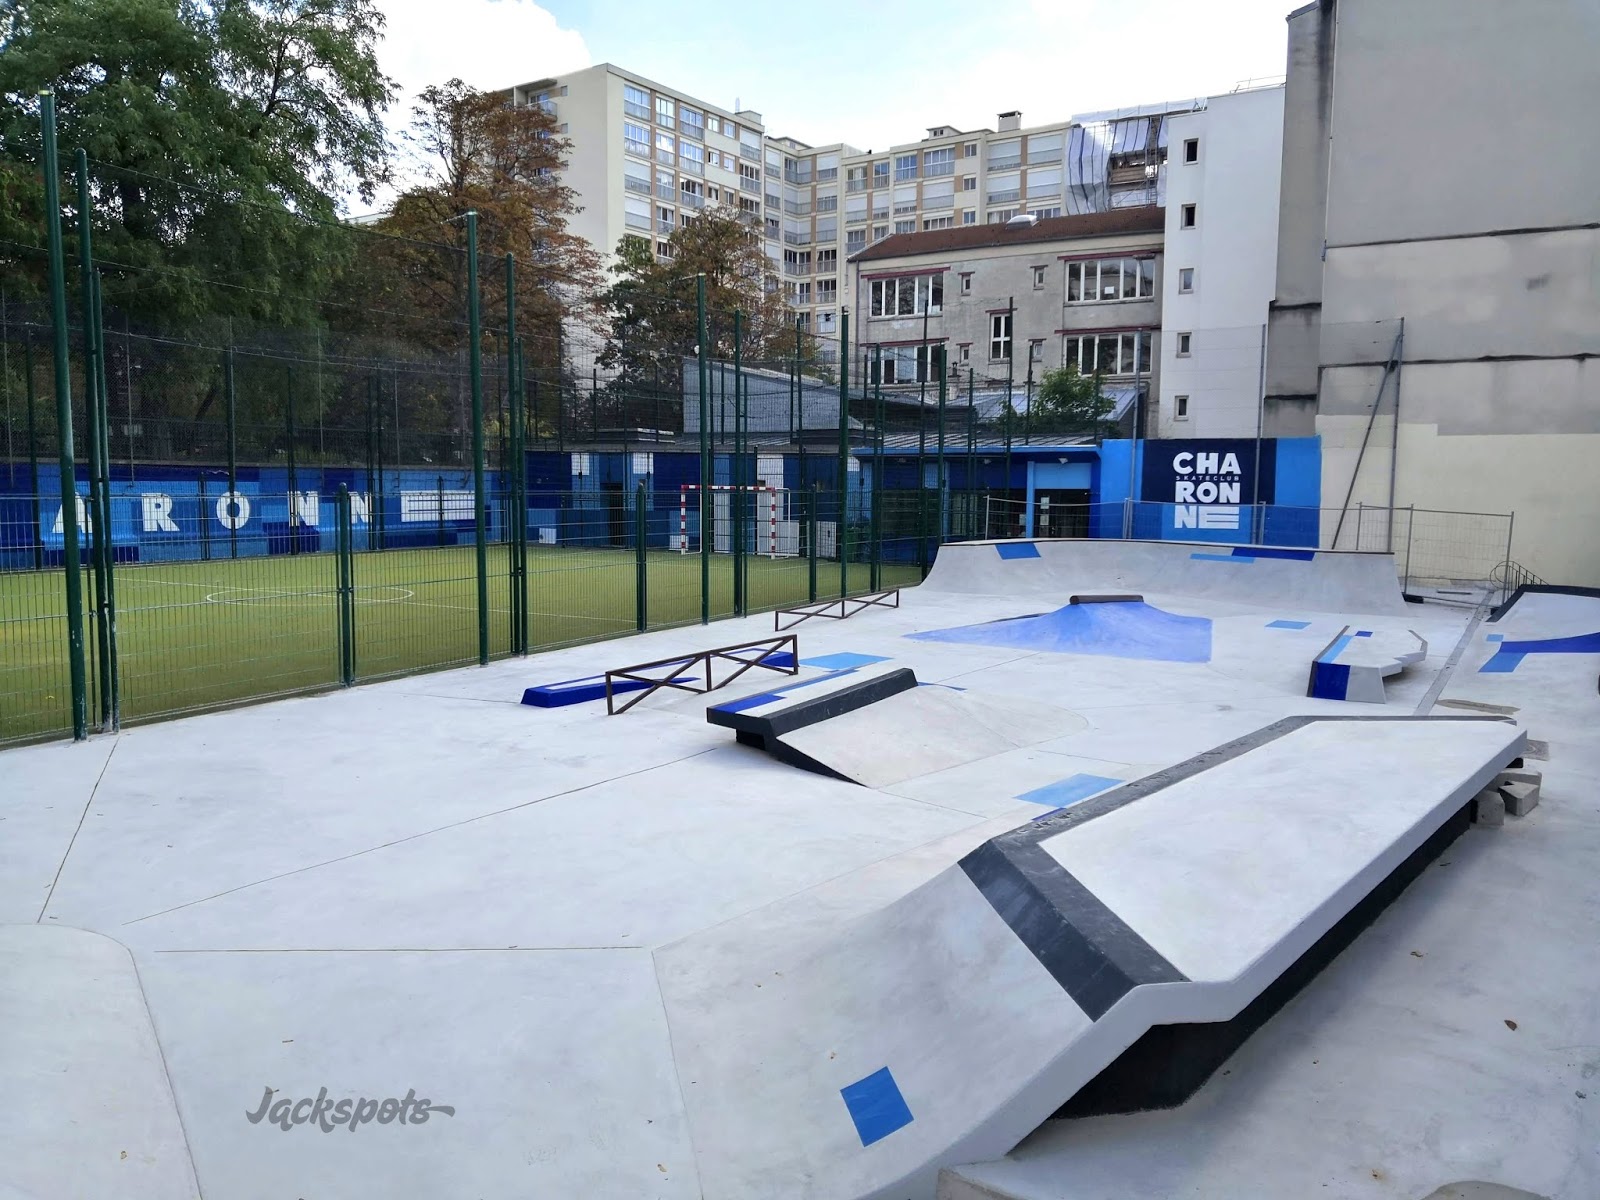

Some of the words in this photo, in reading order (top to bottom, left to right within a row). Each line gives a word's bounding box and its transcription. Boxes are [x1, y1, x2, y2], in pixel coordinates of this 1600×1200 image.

[1173, 452, 1242, 475] CHA
[1175, 481, 1240, 503] RON
[1174, 505, 1240, 529] NE
